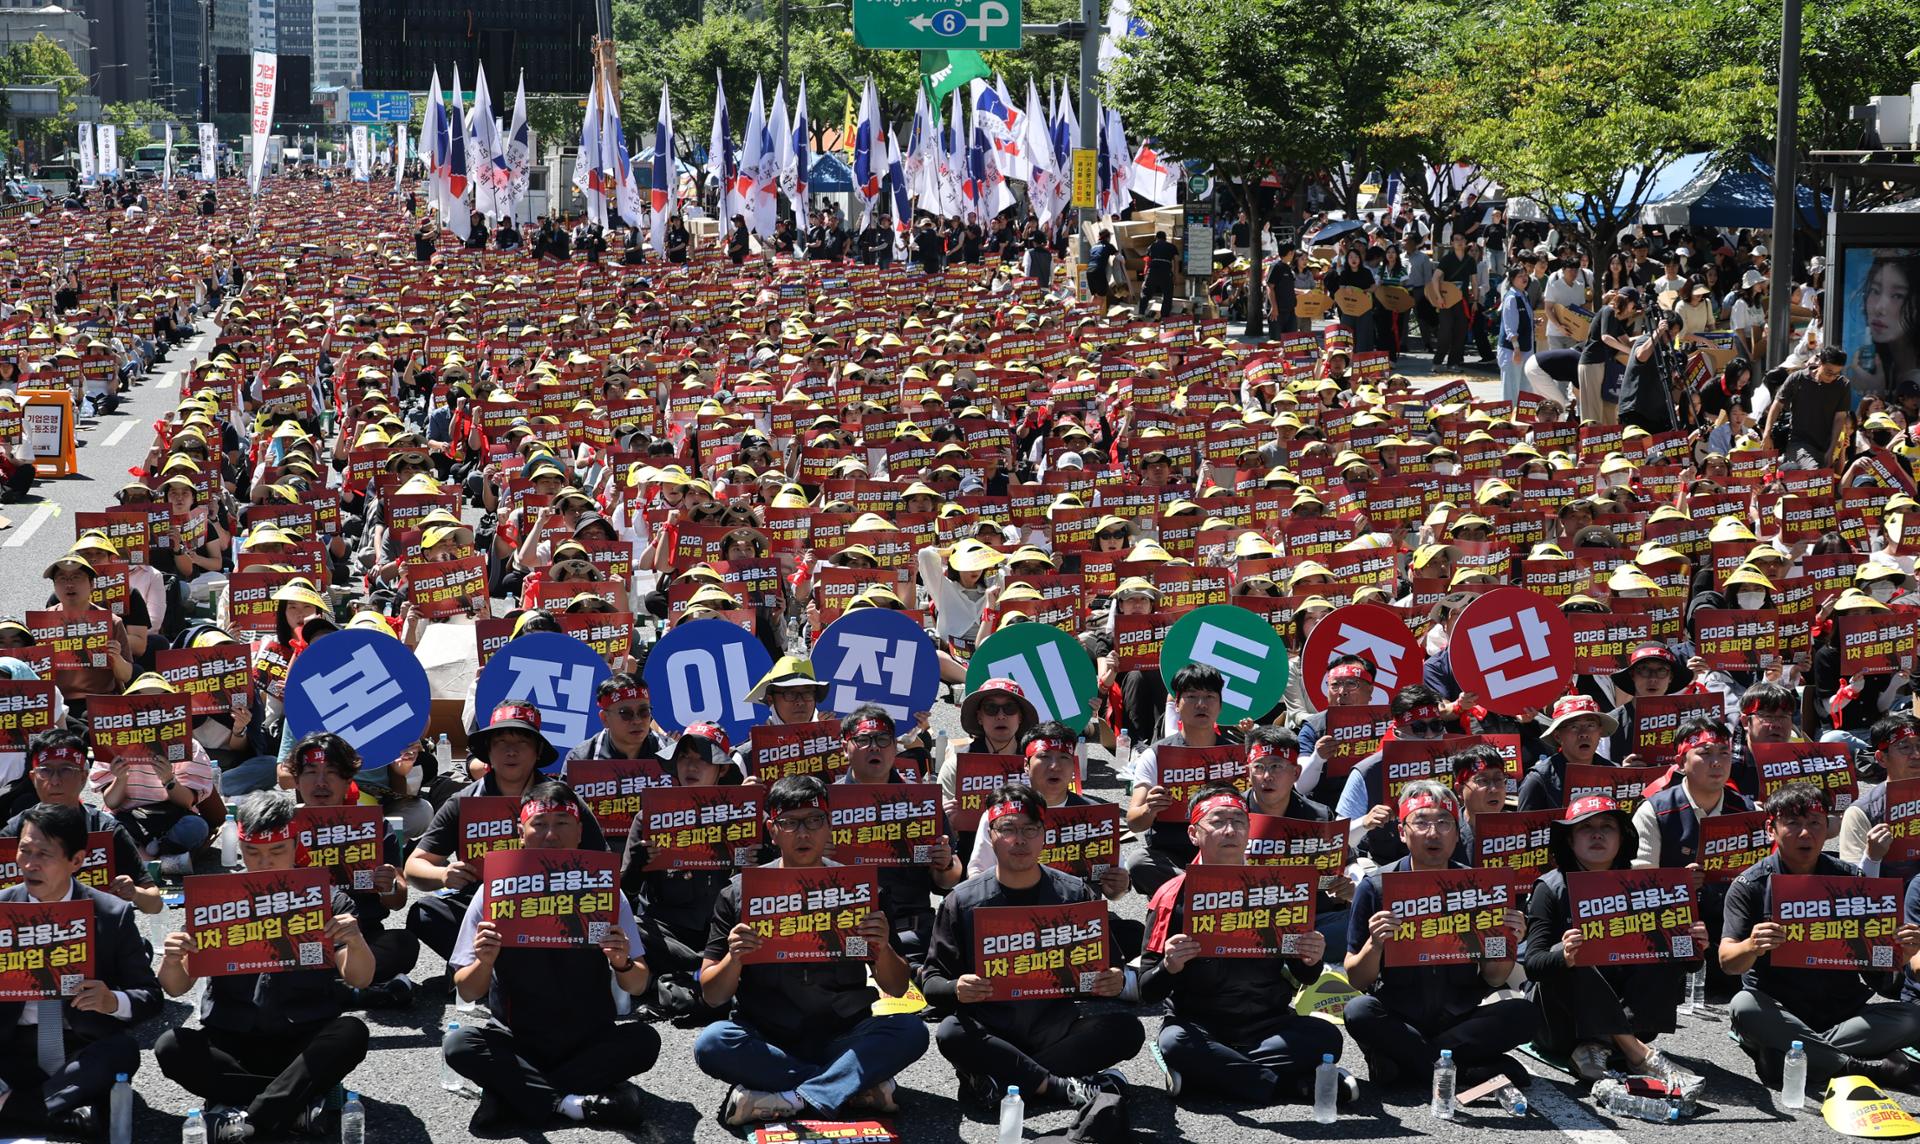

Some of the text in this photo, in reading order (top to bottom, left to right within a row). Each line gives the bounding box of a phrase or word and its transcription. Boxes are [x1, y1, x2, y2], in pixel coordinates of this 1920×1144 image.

[943, 14, 955, 31] 6
[28, 415, 58, 423] 기업은행
[32, 425, 58, 433] 동조합
[110, 522, 144, 536] 금융노조
[127, 535, 144, 548] 승리
[414, 567, 483, 591] 2026 금융노조
[742, 567, 777, 584] 금융노조
[759, 580, 778, 592] 승리
[1158, 578, 1225, 594] 2026 금융노조
[234, 588, 266, 601] 2026
[416, 580, 485, 603] 1차 총파업 승리
[1159, 592, 1226, 607] 1차 총파업 승리
[67, 621, 108, 636] 금융노조
[591, 624, 628, 640] 금융노조
[1120, 630, 1151, 644] 2026
[1701, 621, 1775, 639] 2026 금융노조
[1846, 624, 1914, 645] 2026 금융노조
[610, 639, 628, 652] 승리
[1467, 606, 1558, 700] 단
[1701, 637, 1774, 655] 1차 총파업 승리
[1846, 637, 1914, 659] 1차 총파업 승리
[201, 656, 247, 676] 금융노조
[834, 632, 917, 720] 전
[183, 672, 248, 695] 총파업 승리
[667, 642, 755, 728] 이
[301, 643, 414, 749] 본
[505, 656, 595, 749] 점
[22, 711, 48, 727] 승리
[94, 706, 186, 729] 2026 금융노조
[1641, 714, 1679, 733] 2026
[96, 722, 187, 746] 1차 총파업 승리
[759, 743, 800, 763] 2026
[784, 756, 823, 777] 총파업
[1763, 755, 1847, 777] 2026 금융노조
[962, 775, 1004, 793] 2026
[1828, 771, 1852, 788] 승리
[650, 801, 756, 829] 2026 금융노조
[832, 800, 935, 825] 2026 금융노조
[317, 822, 376, 845] 금융노조
[676, 821, 756, 847] 총파업 승리
[857, 820, 935, 843] 총파업 승리
[1060, 819, 1113, 847] 금융노조
[345, 843, 376, 863] 승리
[1085, 839, 1113, 858] 승리
[1290, 835, 1343, 854] 금융노조
[1483, 834, 1526, 854] 2026
[1705, 834, 1748, 855] 2026
[491, 870, 613, 897] 2026 금융노조
[194, 886, 323, 926] 2026 금융노조
[491, 893, 613, 919] 1차 총파업 승리
[750, 883, 870, 915] 2026 금융노조
[1193, 883, 1309, 910] 2026 금융노조
[1392, 885, 1507, 918] 2026 금융노조
[1579, 885, 1690, 917] 2026 금융노조
[1781, 896, 1896, 919] 2026 금융노조
[228, 911, 324, 945] 총파업 승리
[780, 913, 831, 936] 총파업
[1193, 906, 1308, 933] 1차 총파업 승리
[1421, 913, 1470, 938] 총파업
[1609, 907, 1692, 937] 총파업 승리
[1810, 917, 1896, 941] 총파업 승리
[18, 919, 86, 946] 금융노조
[984, 919, 1102, 954] 2026 금융노조
[50, 943, 86, 966] 승리
[985, 943, 1103, 976] 1차 총파업 승리
